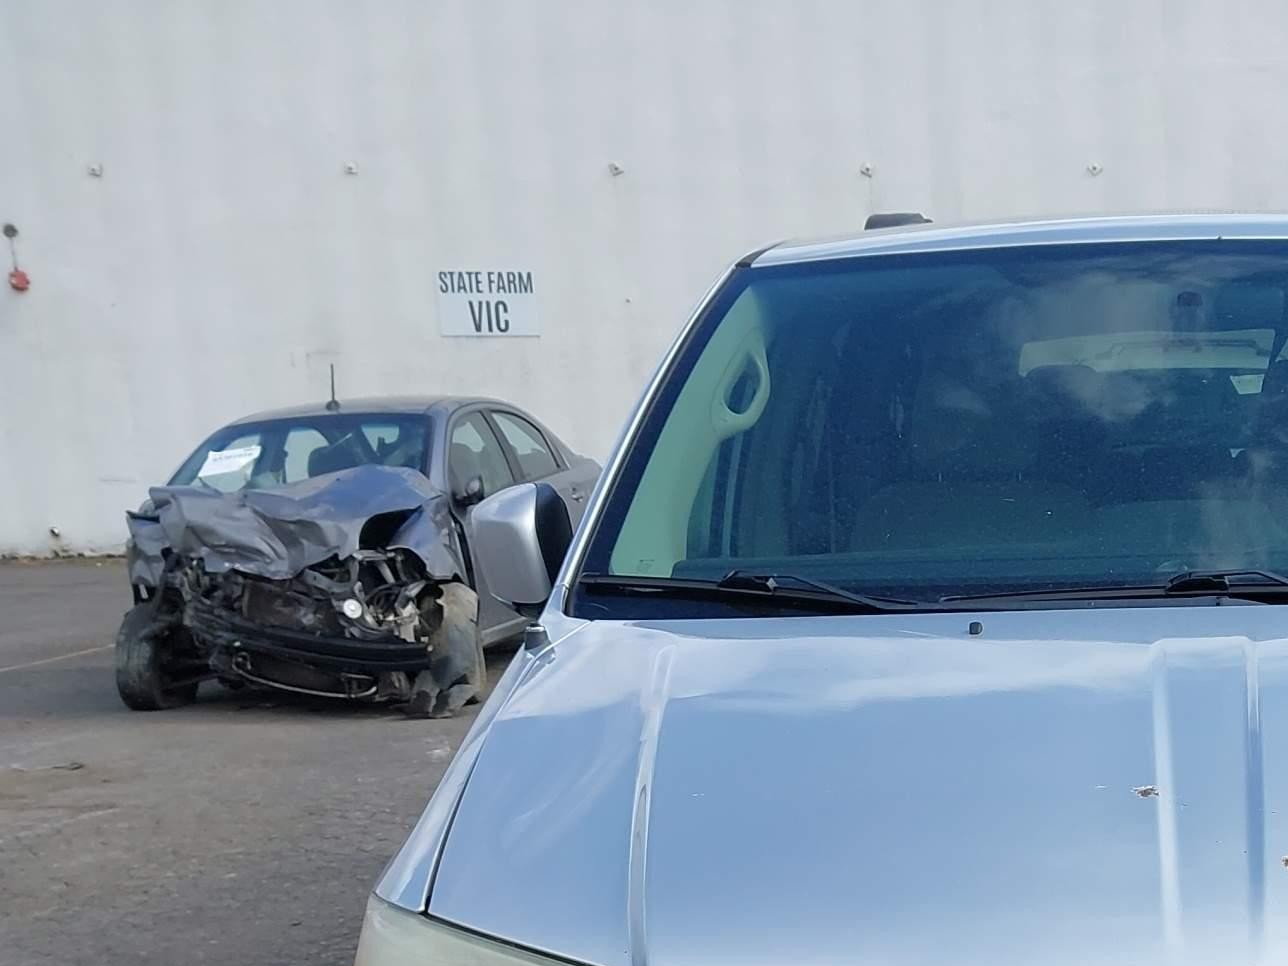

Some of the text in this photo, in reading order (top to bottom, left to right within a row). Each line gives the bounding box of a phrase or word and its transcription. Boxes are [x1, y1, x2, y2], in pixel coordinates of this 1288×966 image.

[438, 271, 534, 294] STATE FARM
[468, 300, 510, 333] VIC
